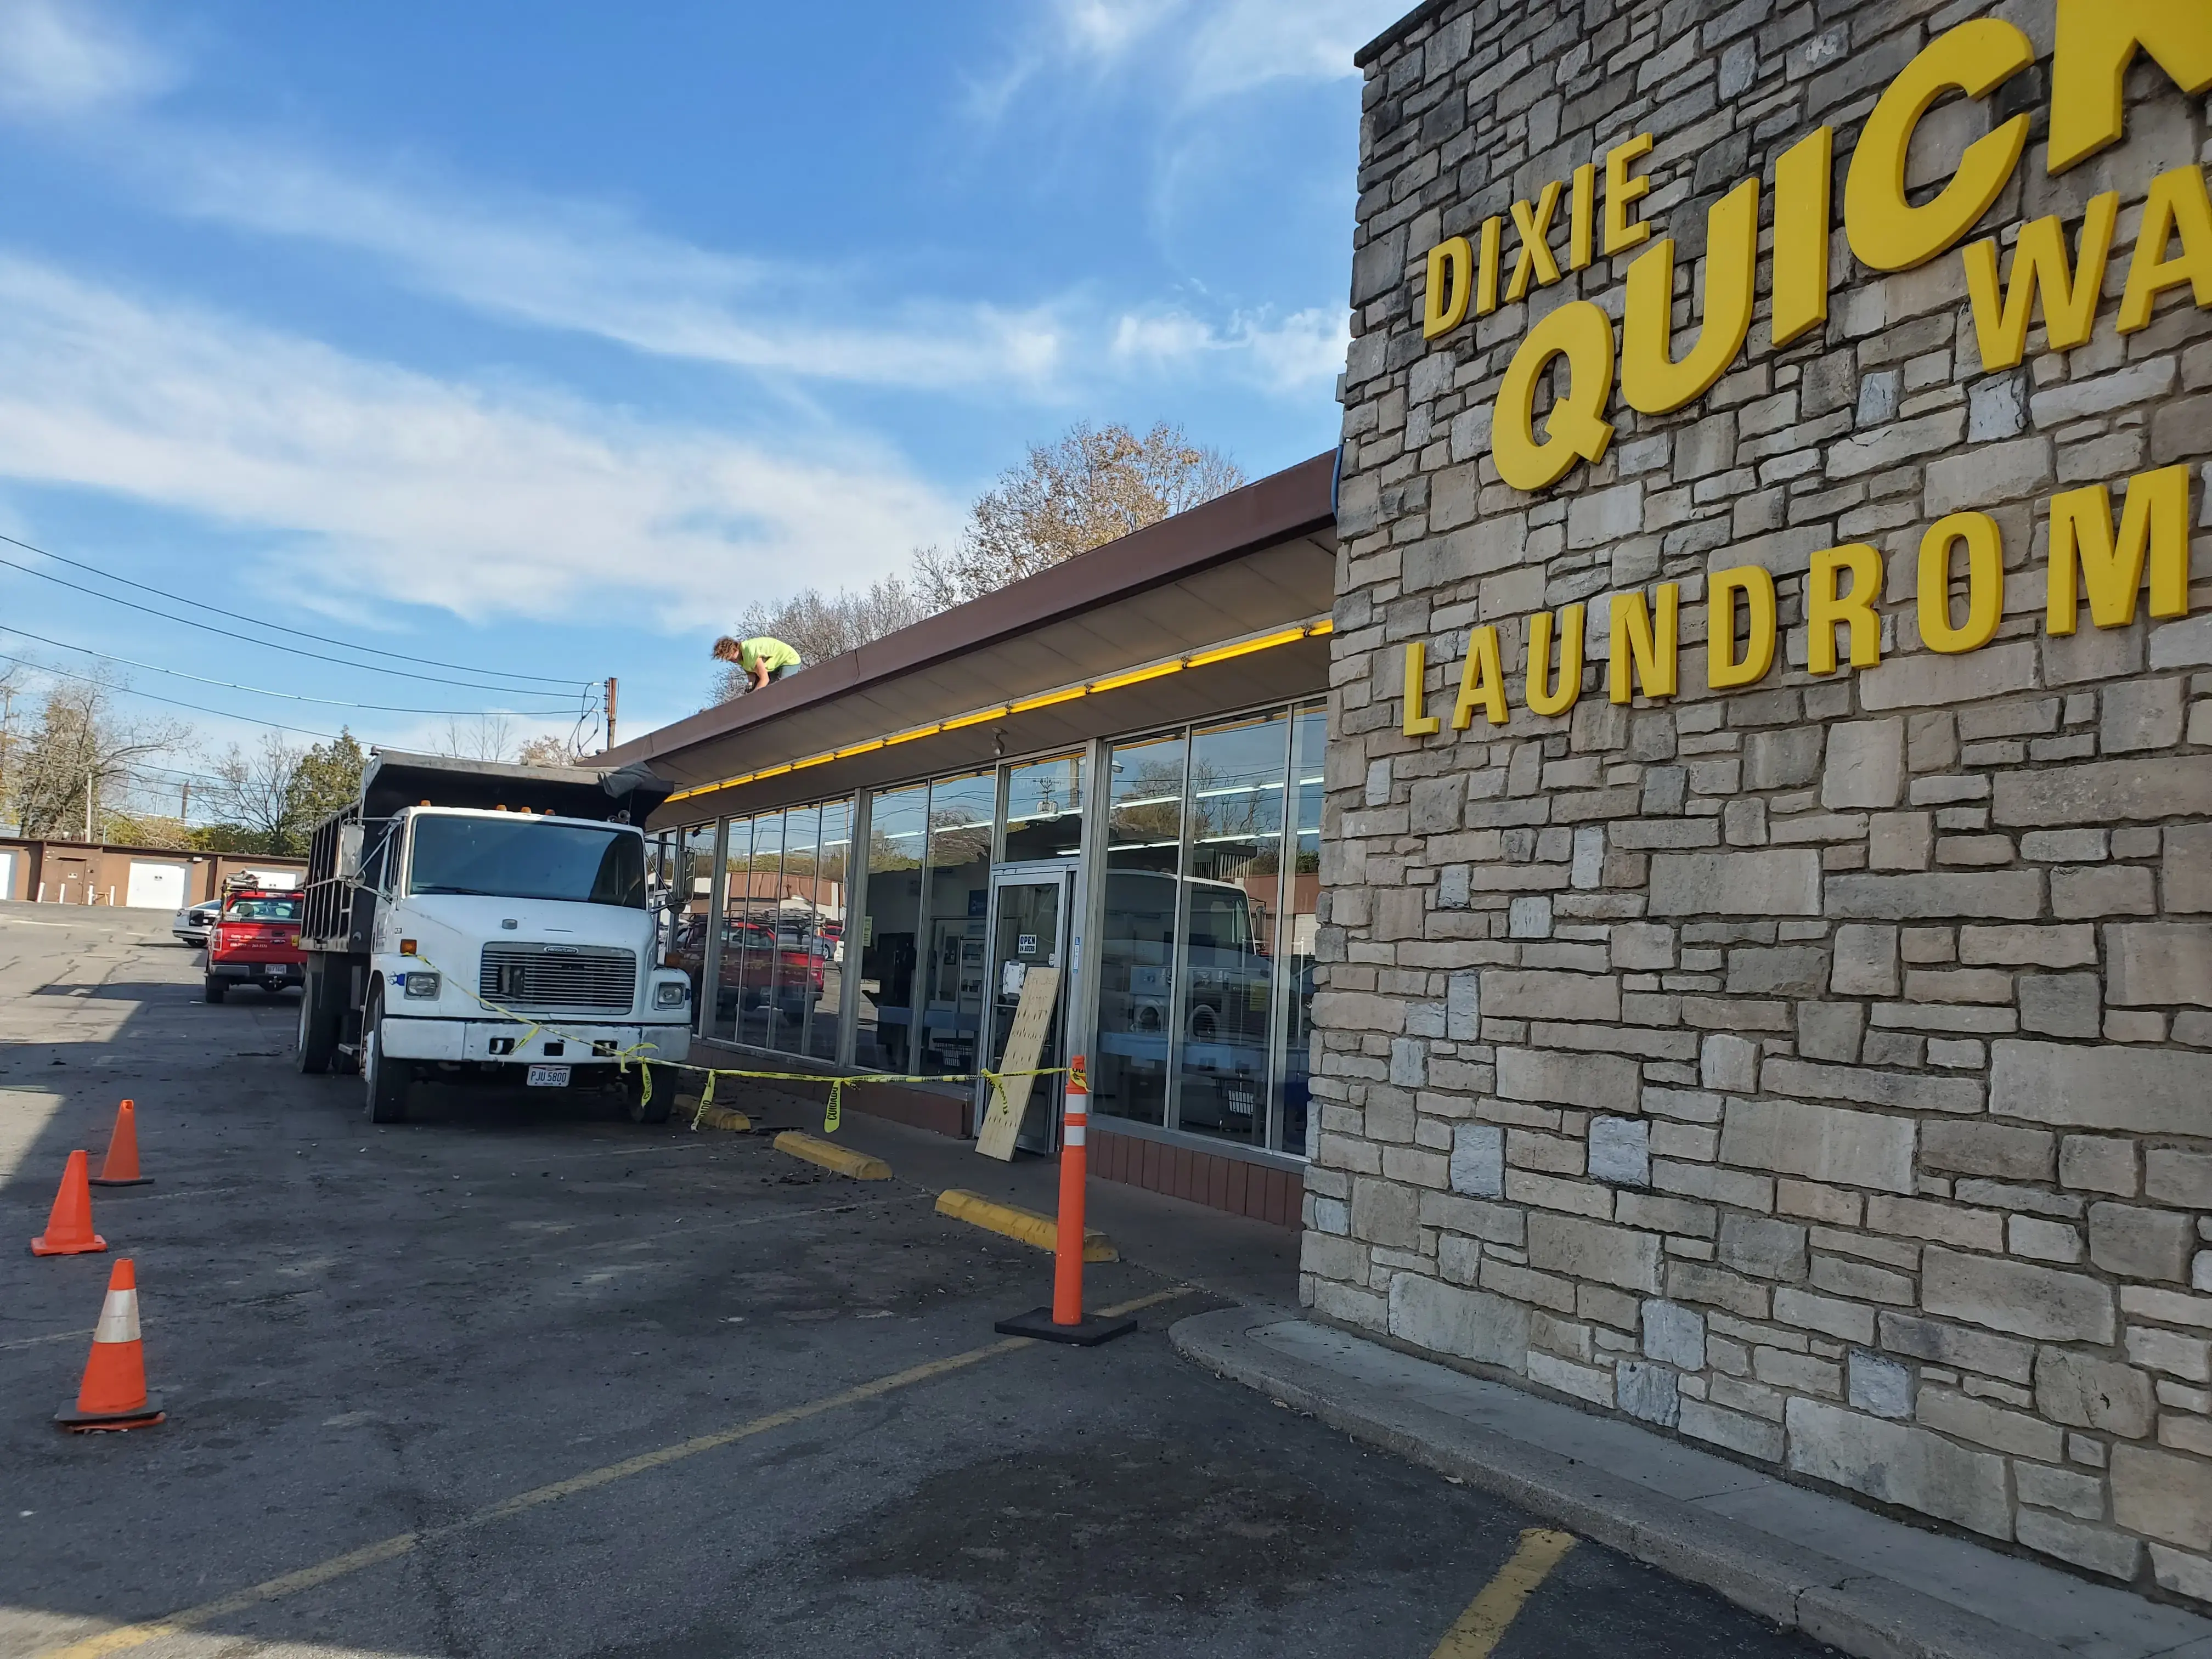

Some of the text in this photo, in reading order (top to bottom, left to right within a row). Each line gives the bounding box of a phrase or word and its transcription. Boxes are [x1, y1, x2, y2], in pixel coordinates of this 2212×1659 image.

[1423, 132, 1654, 341] DIXIE
[1962, 163, 2212, 374] WA
[1403, 464, 2189, 737] LAUNDROM
[1020, 936, 1036, 945] OPEN
[531, 1071, 567, 1082] PJU 5800
[827, 1087, 838, 1120] CUIDADO
